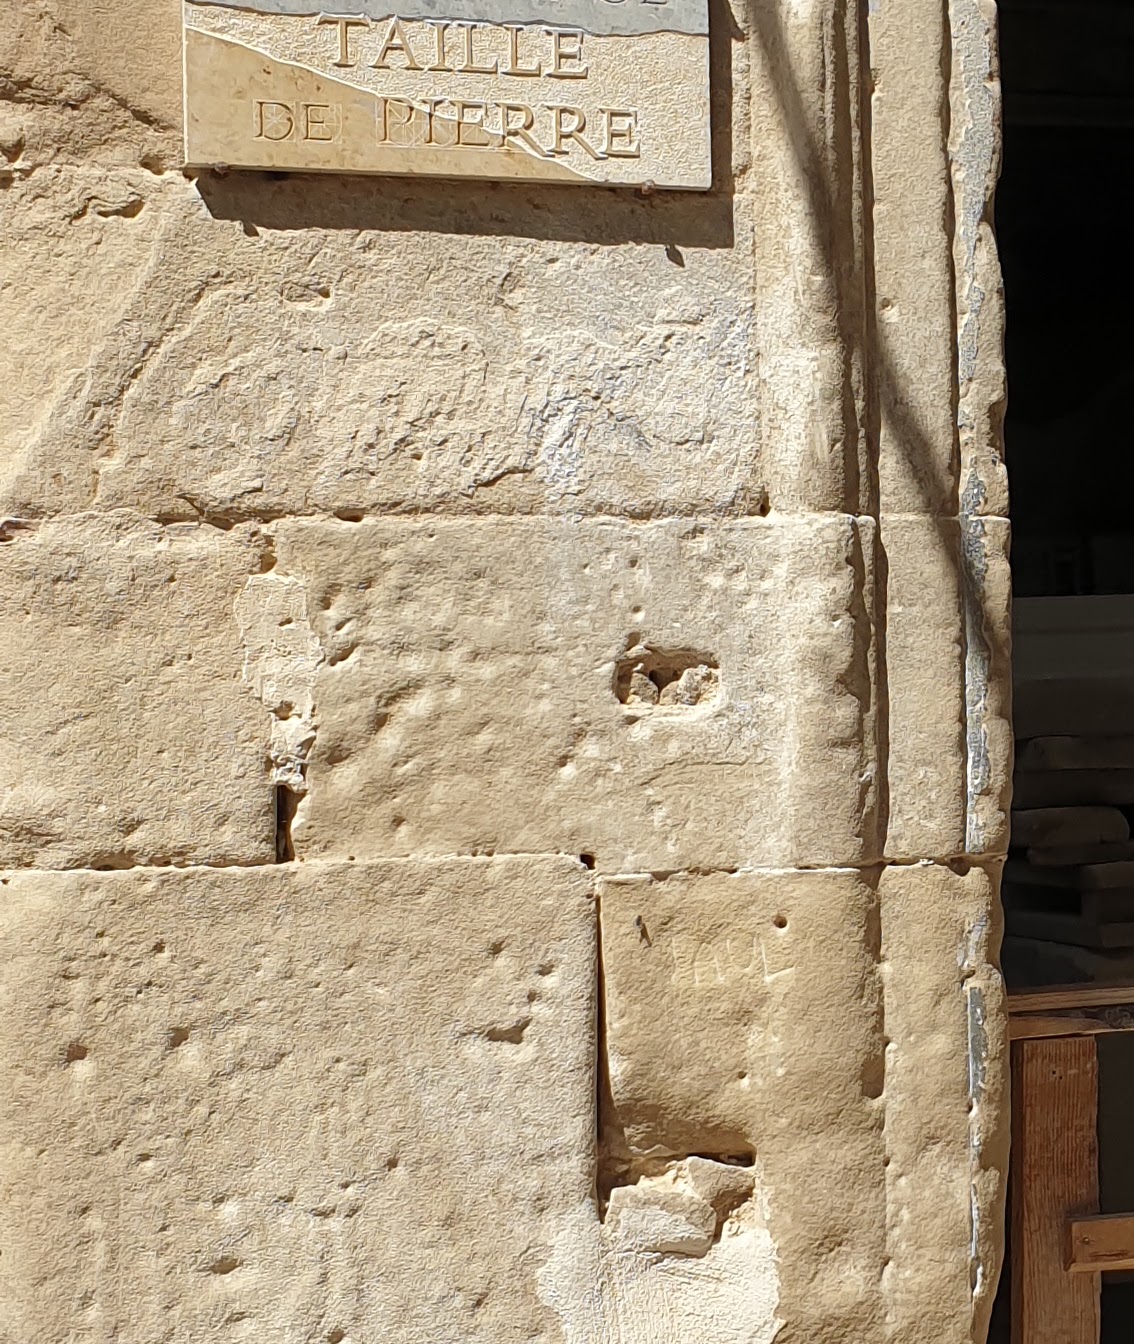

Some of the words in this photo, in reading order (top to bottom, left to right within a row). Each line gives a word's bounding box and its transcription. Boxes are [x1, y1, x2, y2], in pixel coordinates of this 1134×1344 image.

[318, 11, 590, 80] TAILLE
[254, 100, 334, 142] DE
[377, 96, 641, 159] PIERRE
